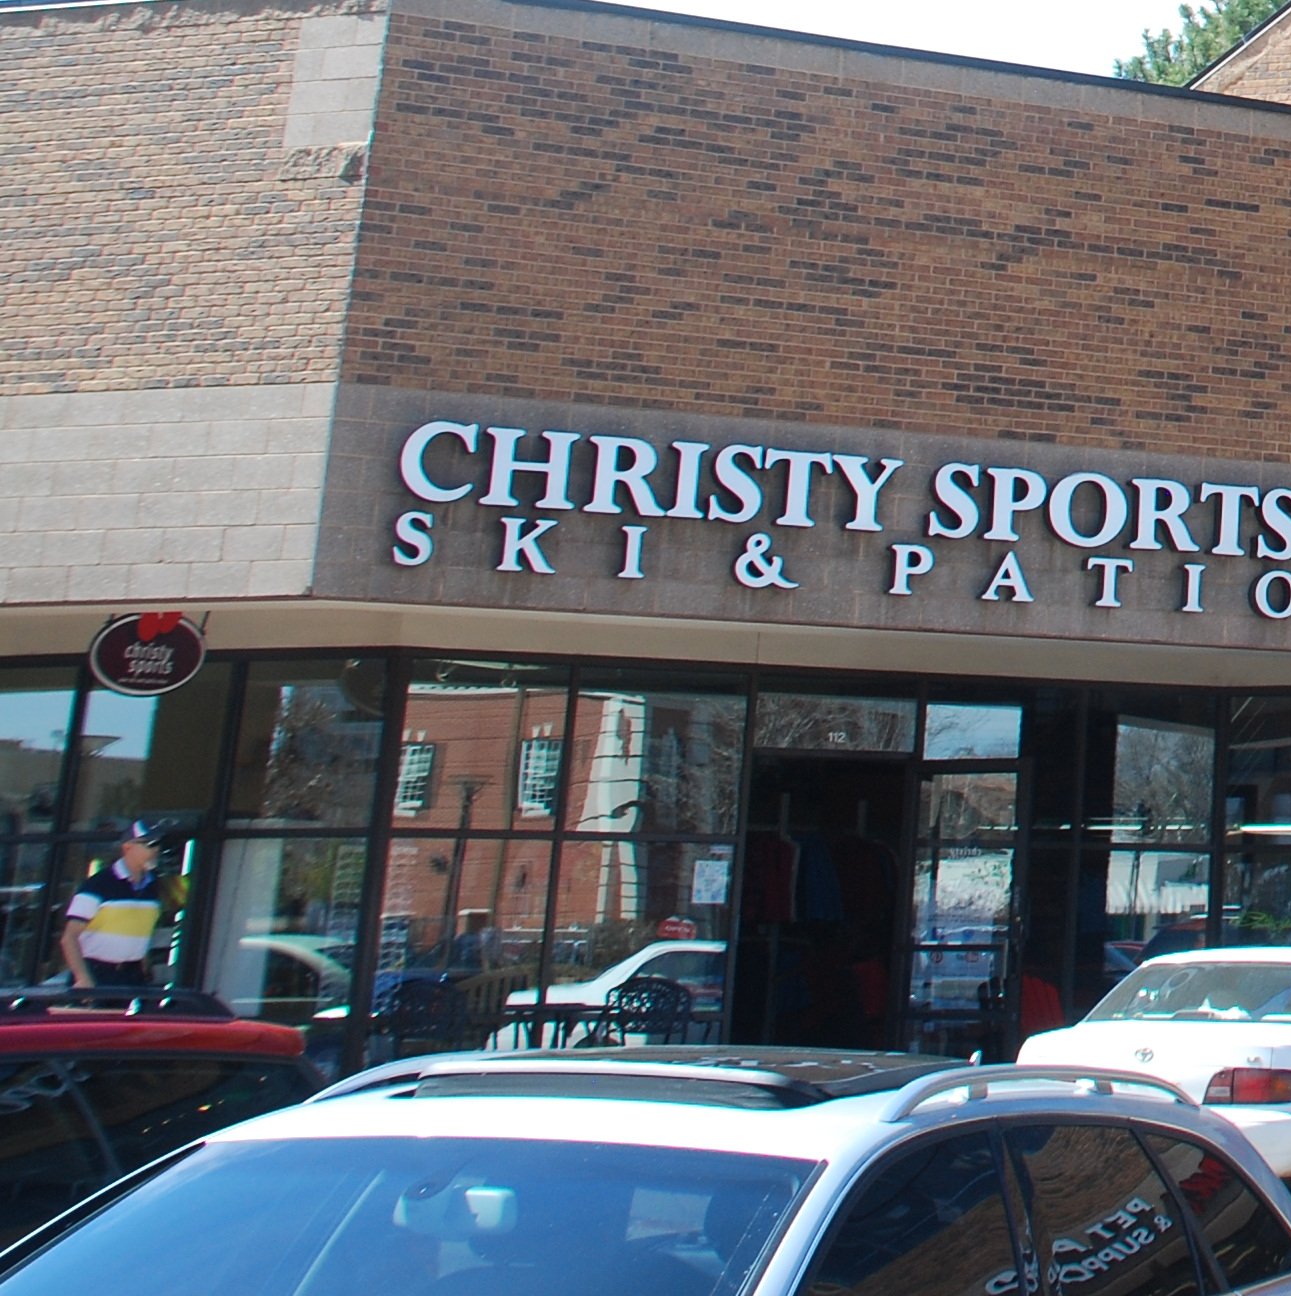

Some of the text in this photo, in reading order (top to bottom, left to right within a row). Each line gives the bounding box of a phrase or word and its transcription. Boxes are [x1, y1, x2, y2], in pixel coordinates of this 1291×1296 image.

[399, 418, 904, 532] CHRISTY
[391, 509, 646, 580] SKI
[734, 532, 799, 590] &
[828, 731, 847, 743] 112
